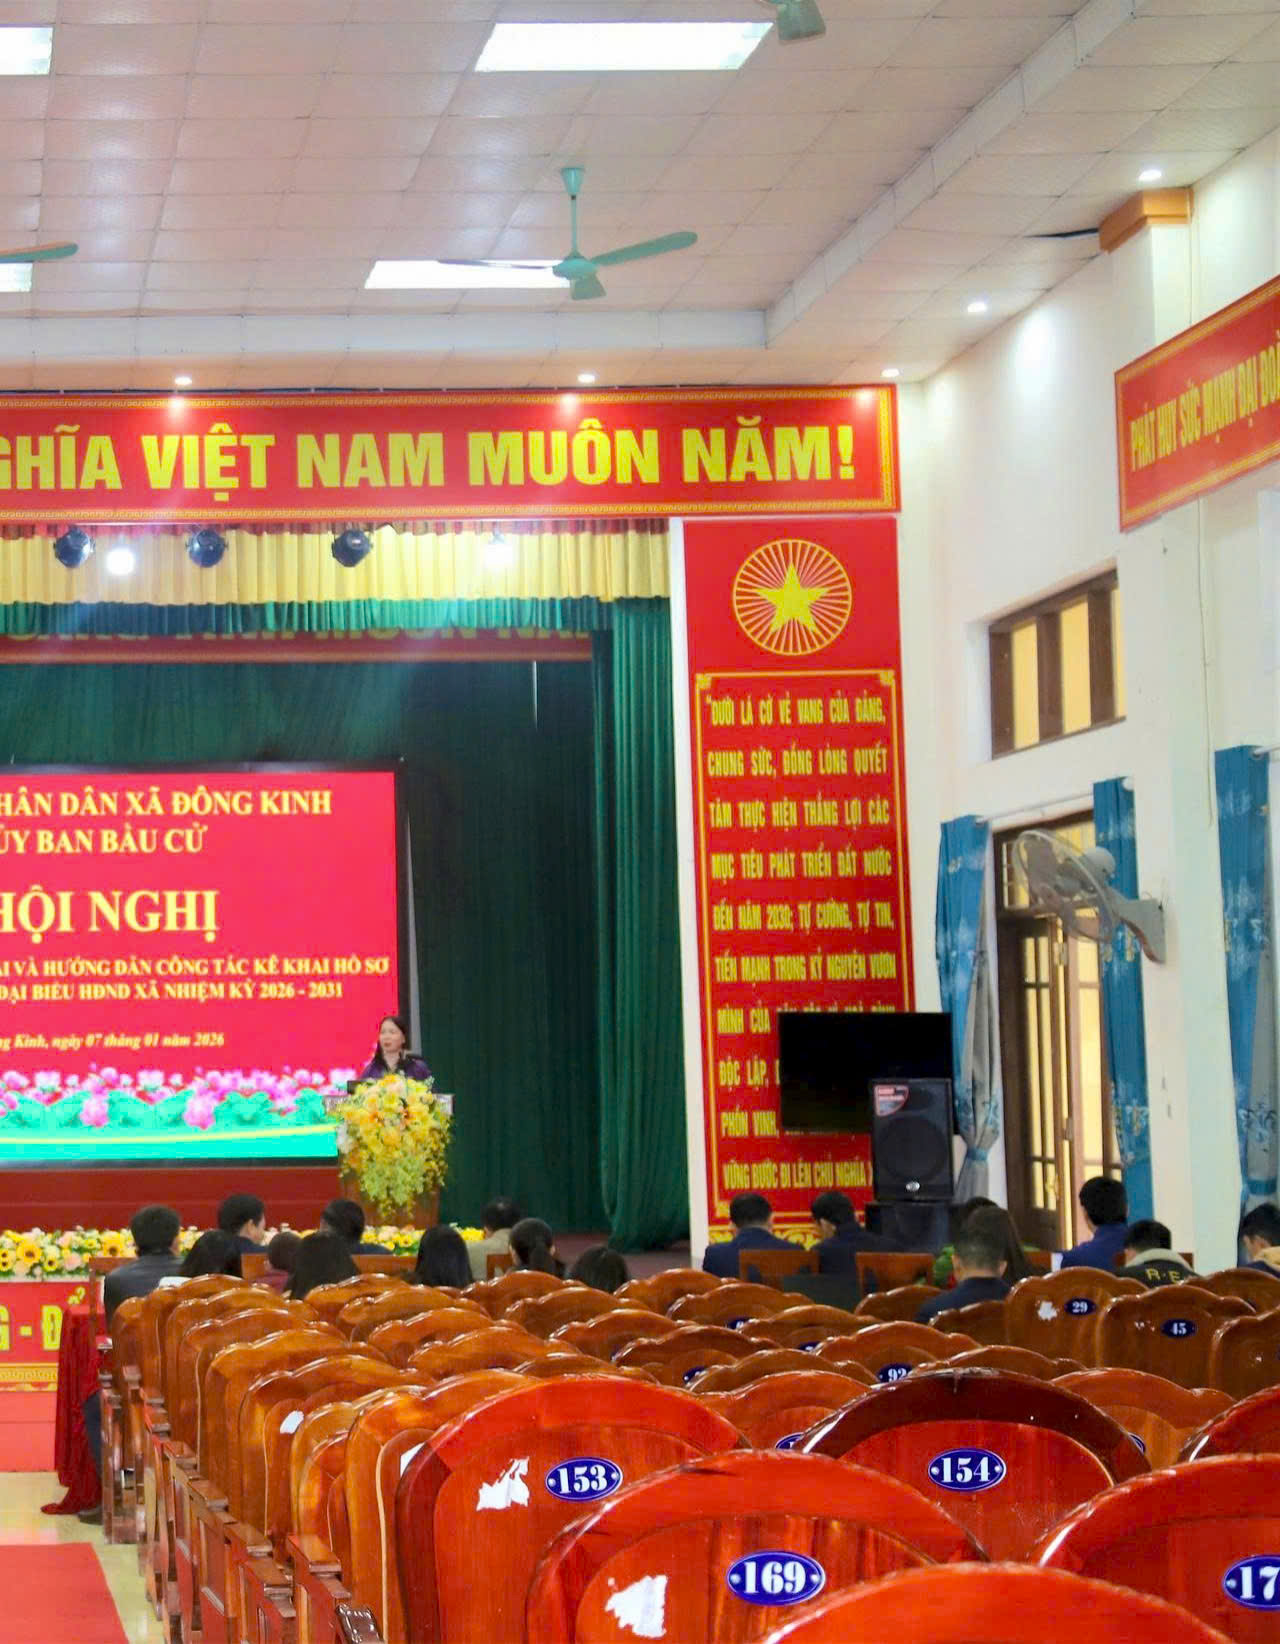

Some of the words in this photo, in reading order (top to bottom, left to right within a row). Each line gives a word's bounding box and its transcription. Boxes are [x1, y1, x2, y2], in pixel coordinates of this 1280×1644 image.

[141, 422, 275, 502] VIỆT
[298, 431, 445, 488] NAM
[468, 419, 660, 486] MUÔN
[686, 414, 855, 483] NĂM!
[60, 786, 118, 816] DÂN
[125, 786, 163, 815] XÃ
[172, 785, 252, 816] ĐÔNG
[260, 790, 332, 815] KINH
[37, 830, 93, 853] BAN
[101, 823, 157, 853] BẦU
[165, 825, 209, 853] CỬ
[89, 890, 220, 942] NGHỊ
[12, 960, 38, 976] VÀ
[44, 956, 110, 976] HƯỚNG
[114, 957, 151, 975] DẪN
[156, 956, 208, 975] CÔNG
[214, 957, 249, 974] TÁC
[254, 956, 278, 974] KÊ
[284, 959, 330, 974] KHAI
[334, 956, 361, 974] HỒ
[366, 957, 389, 974] SƠ
[80, 984, 131, 999] HĐND
[134, 982, 160, 999] XÃ
[164, 982, 224, 1002] NHIỆM
[260, 983, 294, 998] 2026
[309, 982, 342, 998] 2031
[14, 1034, 48, 1050] Kinh,
[52, 1036, 83, 1050] ngày
[86, 1034, 102, 1047] 07
[144, 1034, 158, 1046] 01
[162, 1034, 191, 1046] năm
[194, 1033, 224, 1046] 2026
[1072, 1301, 1088, 1313] 29
[1171, 1322, 1186, 1335] 45
[558, 1465, 608, 1495] 153
[940, 1456, 991, 1483] 154
[743, 1560, 805, 1595] 169
